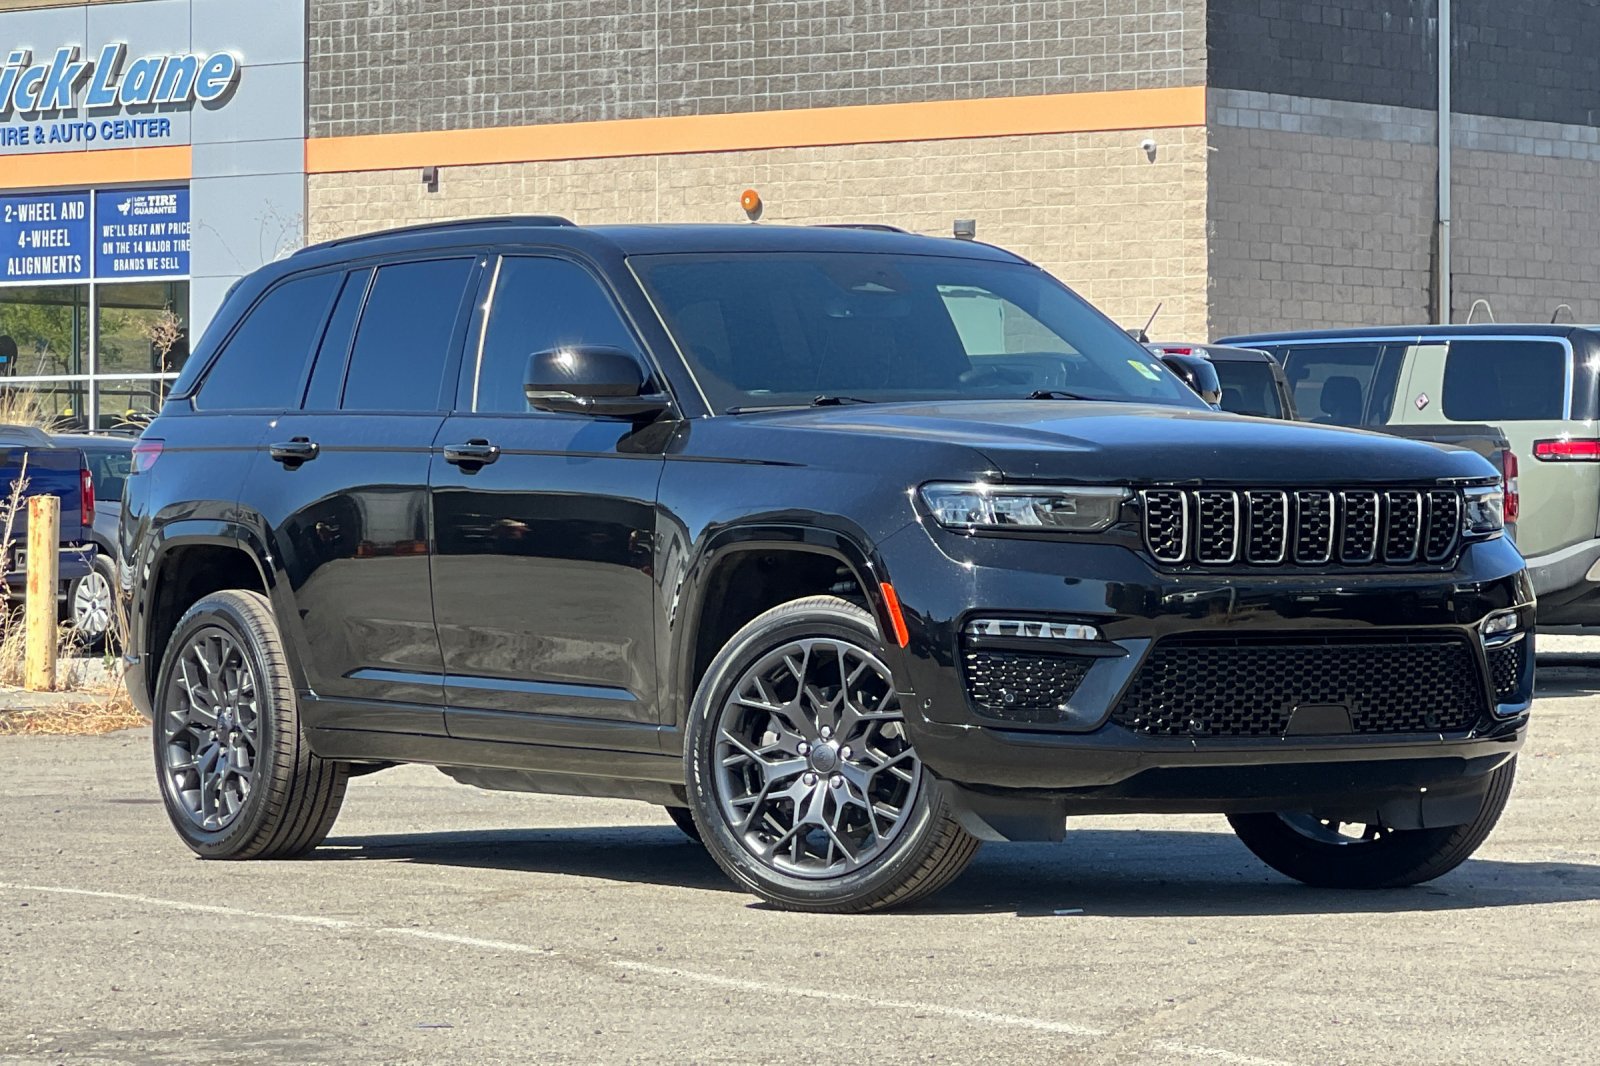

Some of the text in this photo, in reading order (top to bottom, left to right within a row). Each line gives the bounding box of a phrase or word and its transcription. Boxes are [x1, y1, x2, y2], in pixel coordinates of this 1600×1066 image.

[85, 43, 237, 108] Lane
[0, 117, 171, 146] IRE & AUTO CENTER
[147, 194, 177, 206] TIRE
[5, 201, 85, 223] 2-WHEEL AND
[134, 206, 177, 215] GUARANTEE
[103, 221, 190, 237] WE'LL BEAT ANY PRICE
[18, 229, 71, 248] 4-WHEEL
[103, 239, 190, 255] ON THE 14 MAJOR TIRE
[7, 255, 82, 276] ALIGNMENTS
[113, 257, 179, 272] BRANDS WE SELL
